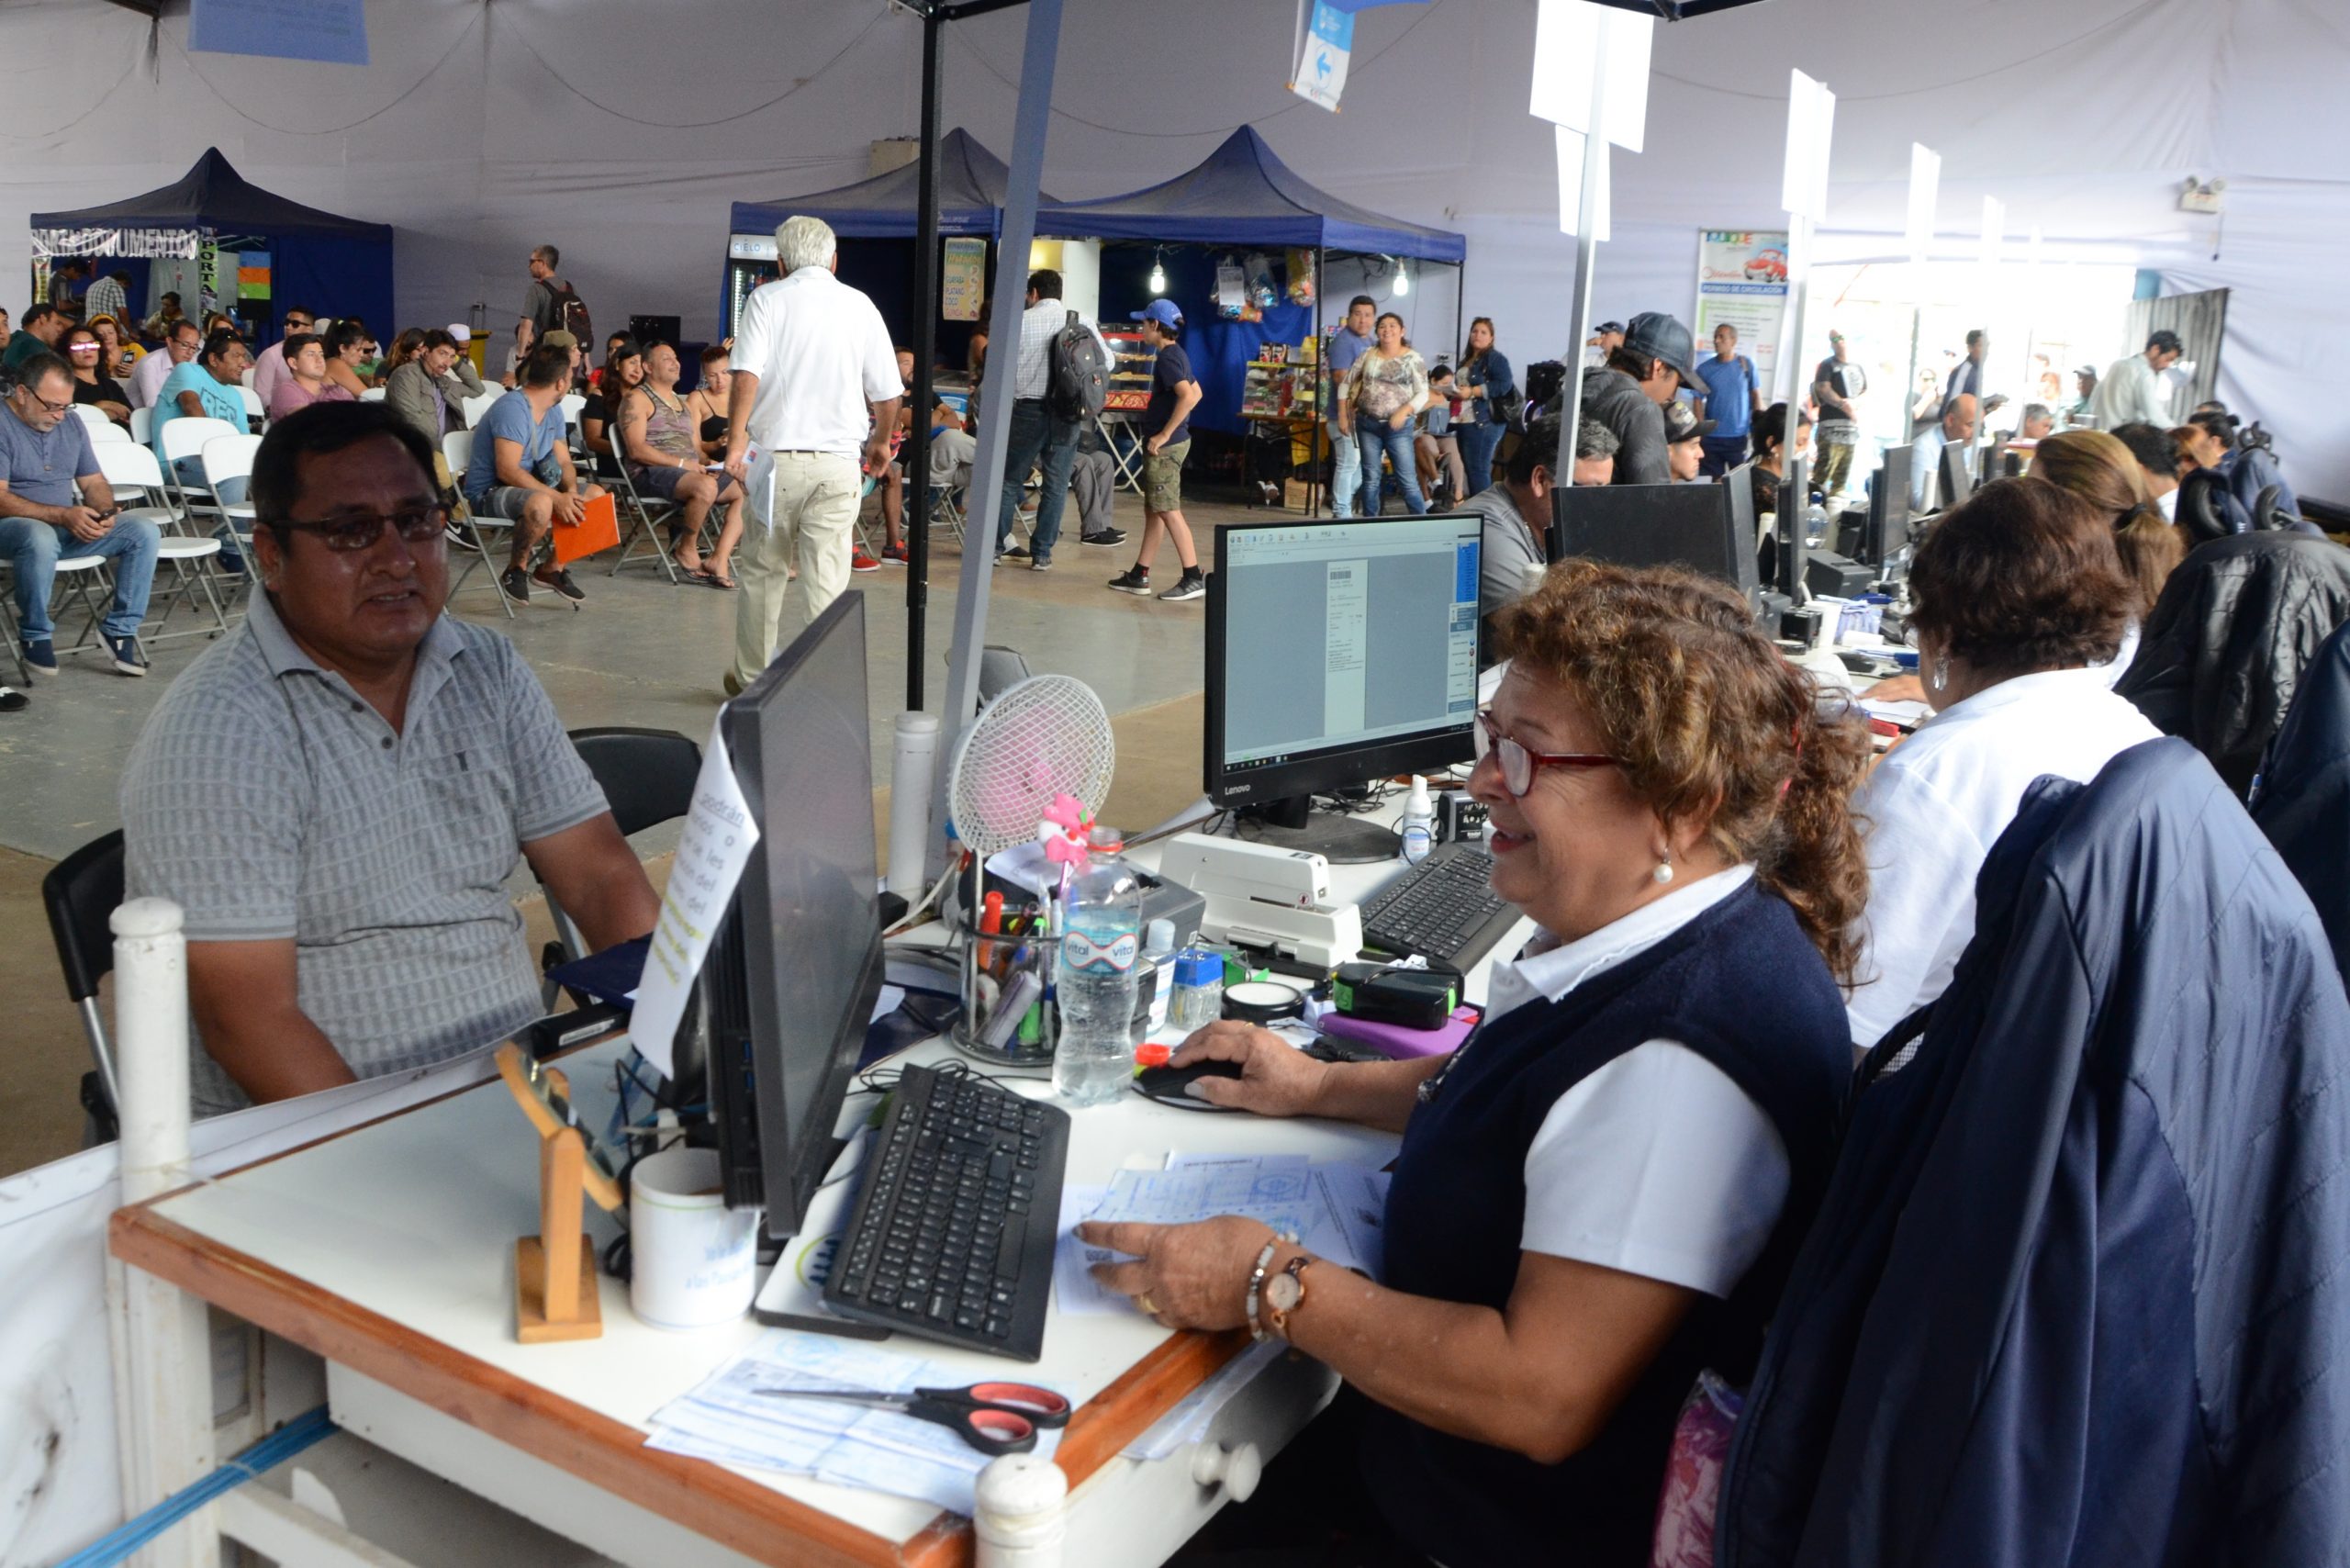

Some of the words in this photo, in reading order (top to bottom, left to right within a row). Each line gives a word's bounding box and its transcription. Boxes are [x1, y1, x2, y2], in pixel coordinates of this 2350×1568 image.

[81, 228, 198, 259] DOCUMENTOS
[1225, 784, 1251, 795] Lenovo
[706, 849, 724, 870] les
[696, 873, 716, 893] del
